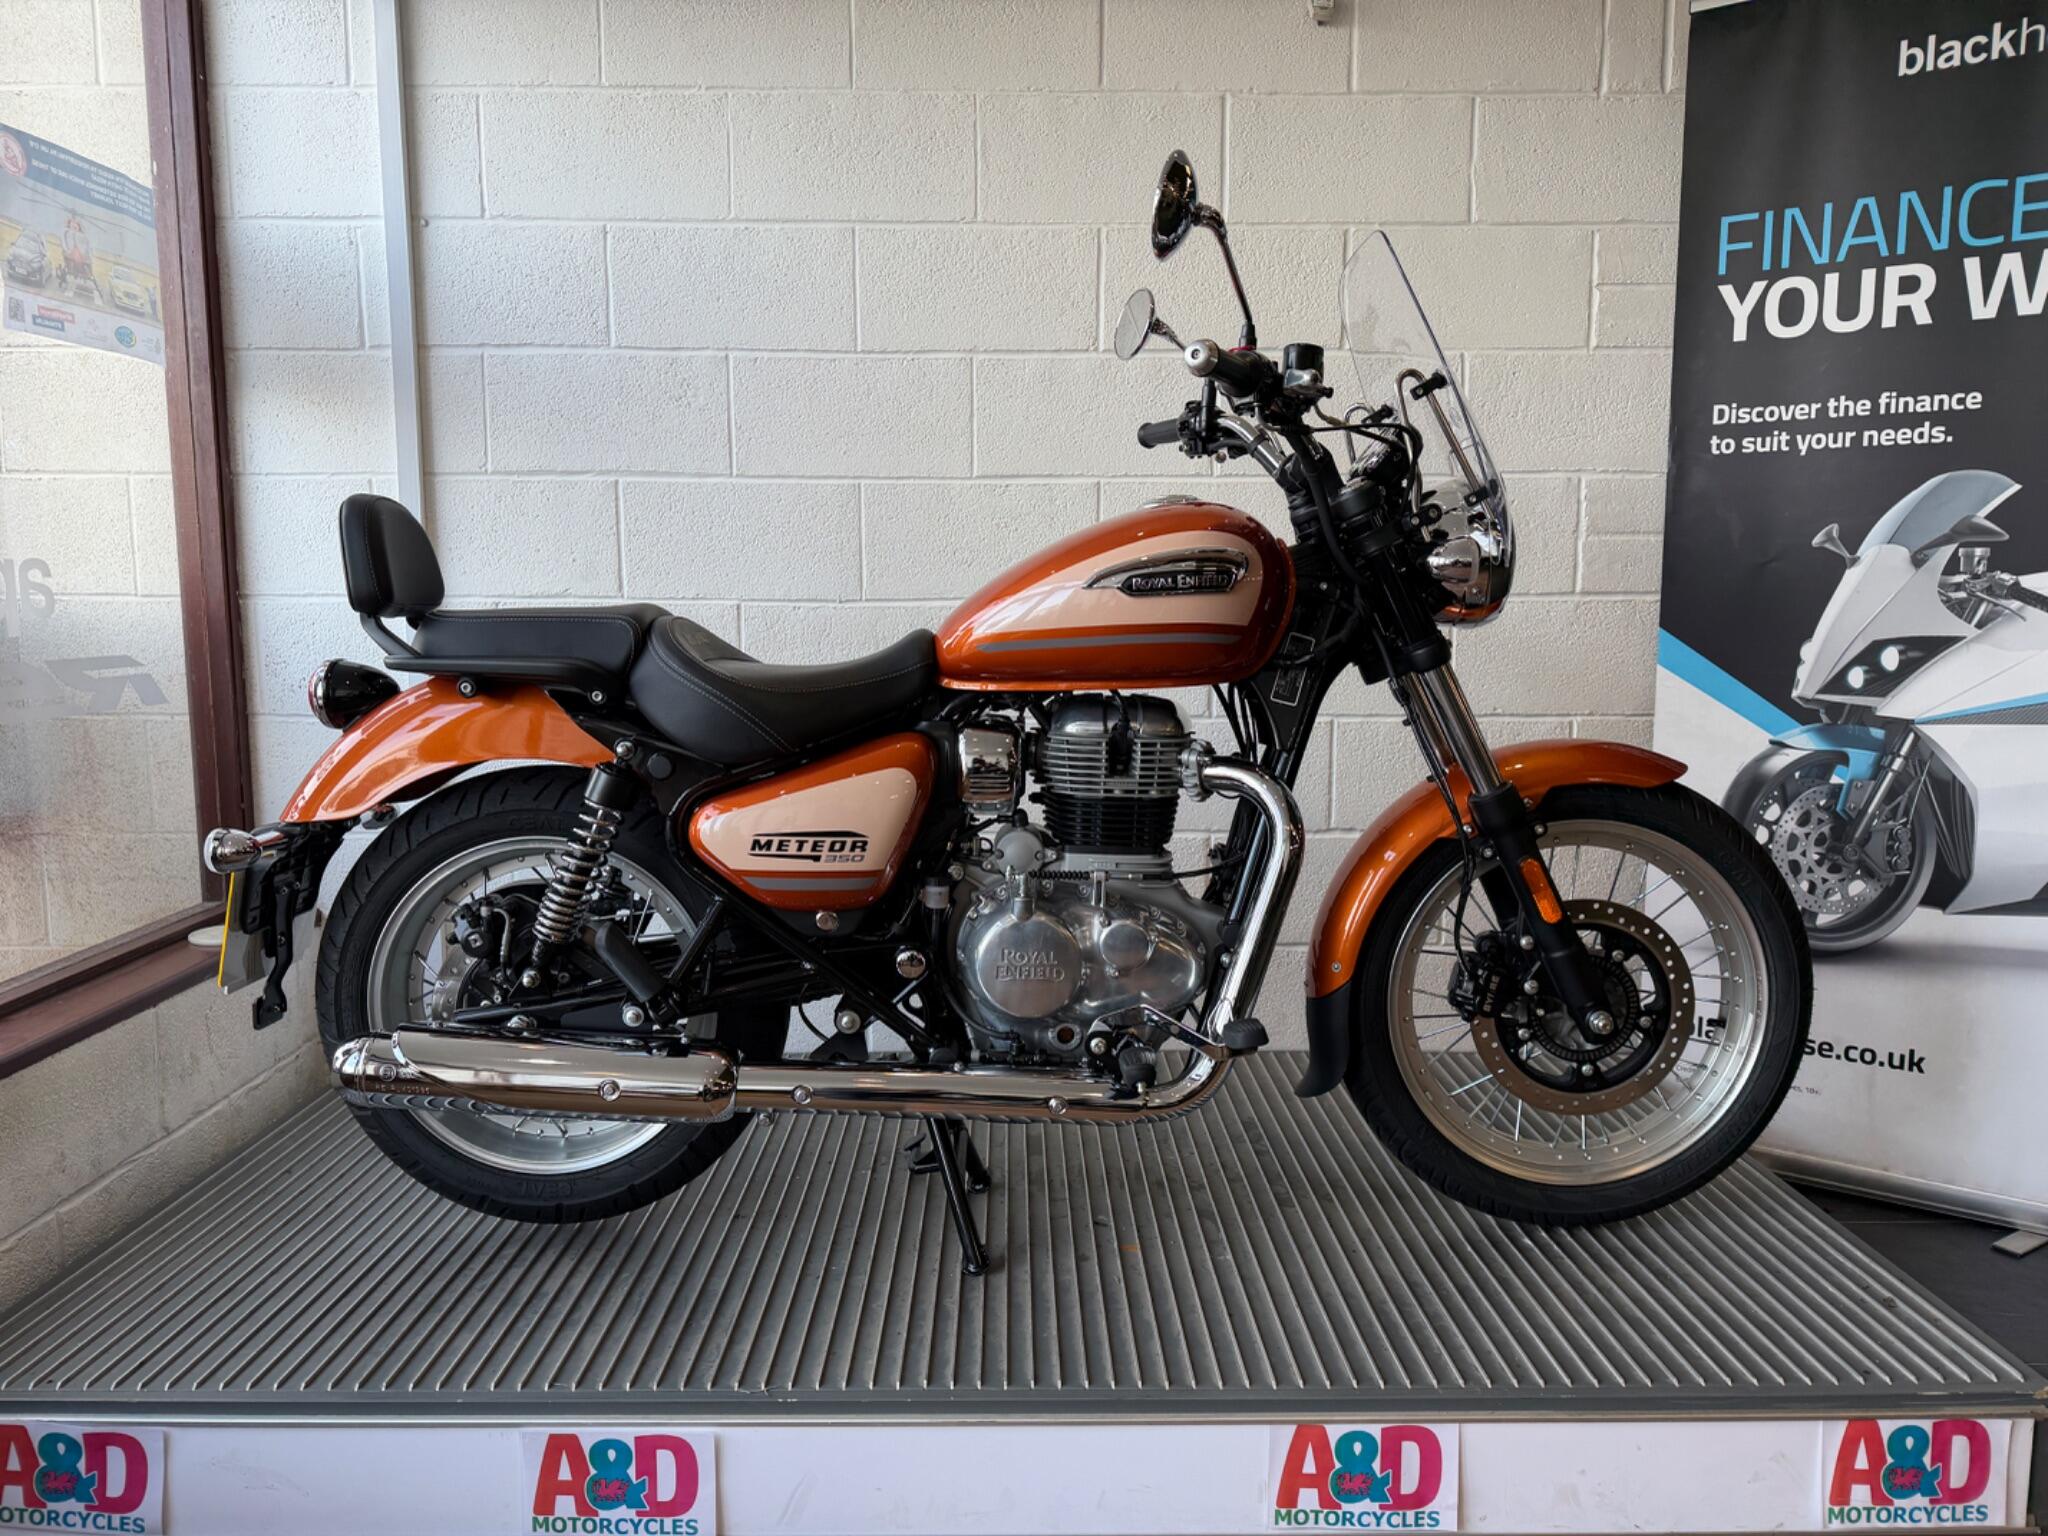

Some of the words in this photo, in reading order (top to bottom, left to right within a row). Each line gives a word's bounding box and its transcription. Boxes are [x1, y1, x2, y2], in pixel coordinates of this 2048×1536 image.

[1716, 171, 2048, 275] FINANCE
[1717, 263, 1937, 343] YOUR
[1712, 402, 1822, 426] Discover
[1827, 395, 1872, 418] the
[1878, 391, 1983, 415] finance
[1709, 434, 1736, 455] to
[1741, 430, 1790, 453] suit
[1796, 430, 1856, 456] your
[1862, 421, 1953, 447] needs.
[750, 838, 869, 853] METEOR
[824, 854, 865, 864] 350
[995, 964, 1065, 982] ENFIELD
[1001, 947, 1058, 966] ROYAL
[0, 1424, 149, 1515] A&D
[532, 1433, 699, 1518] A&D
[1275, 1423, 1442, 1511] A&D
[1829, 1418, 1992, 1507] A&D
[531, 1515, 699, 1536] MOTORCYCLES
[1274, 1508, 1440, 1529] MOTORCYCLES
[1828, 1504, 1989, 1525] MOTORCYCLES
